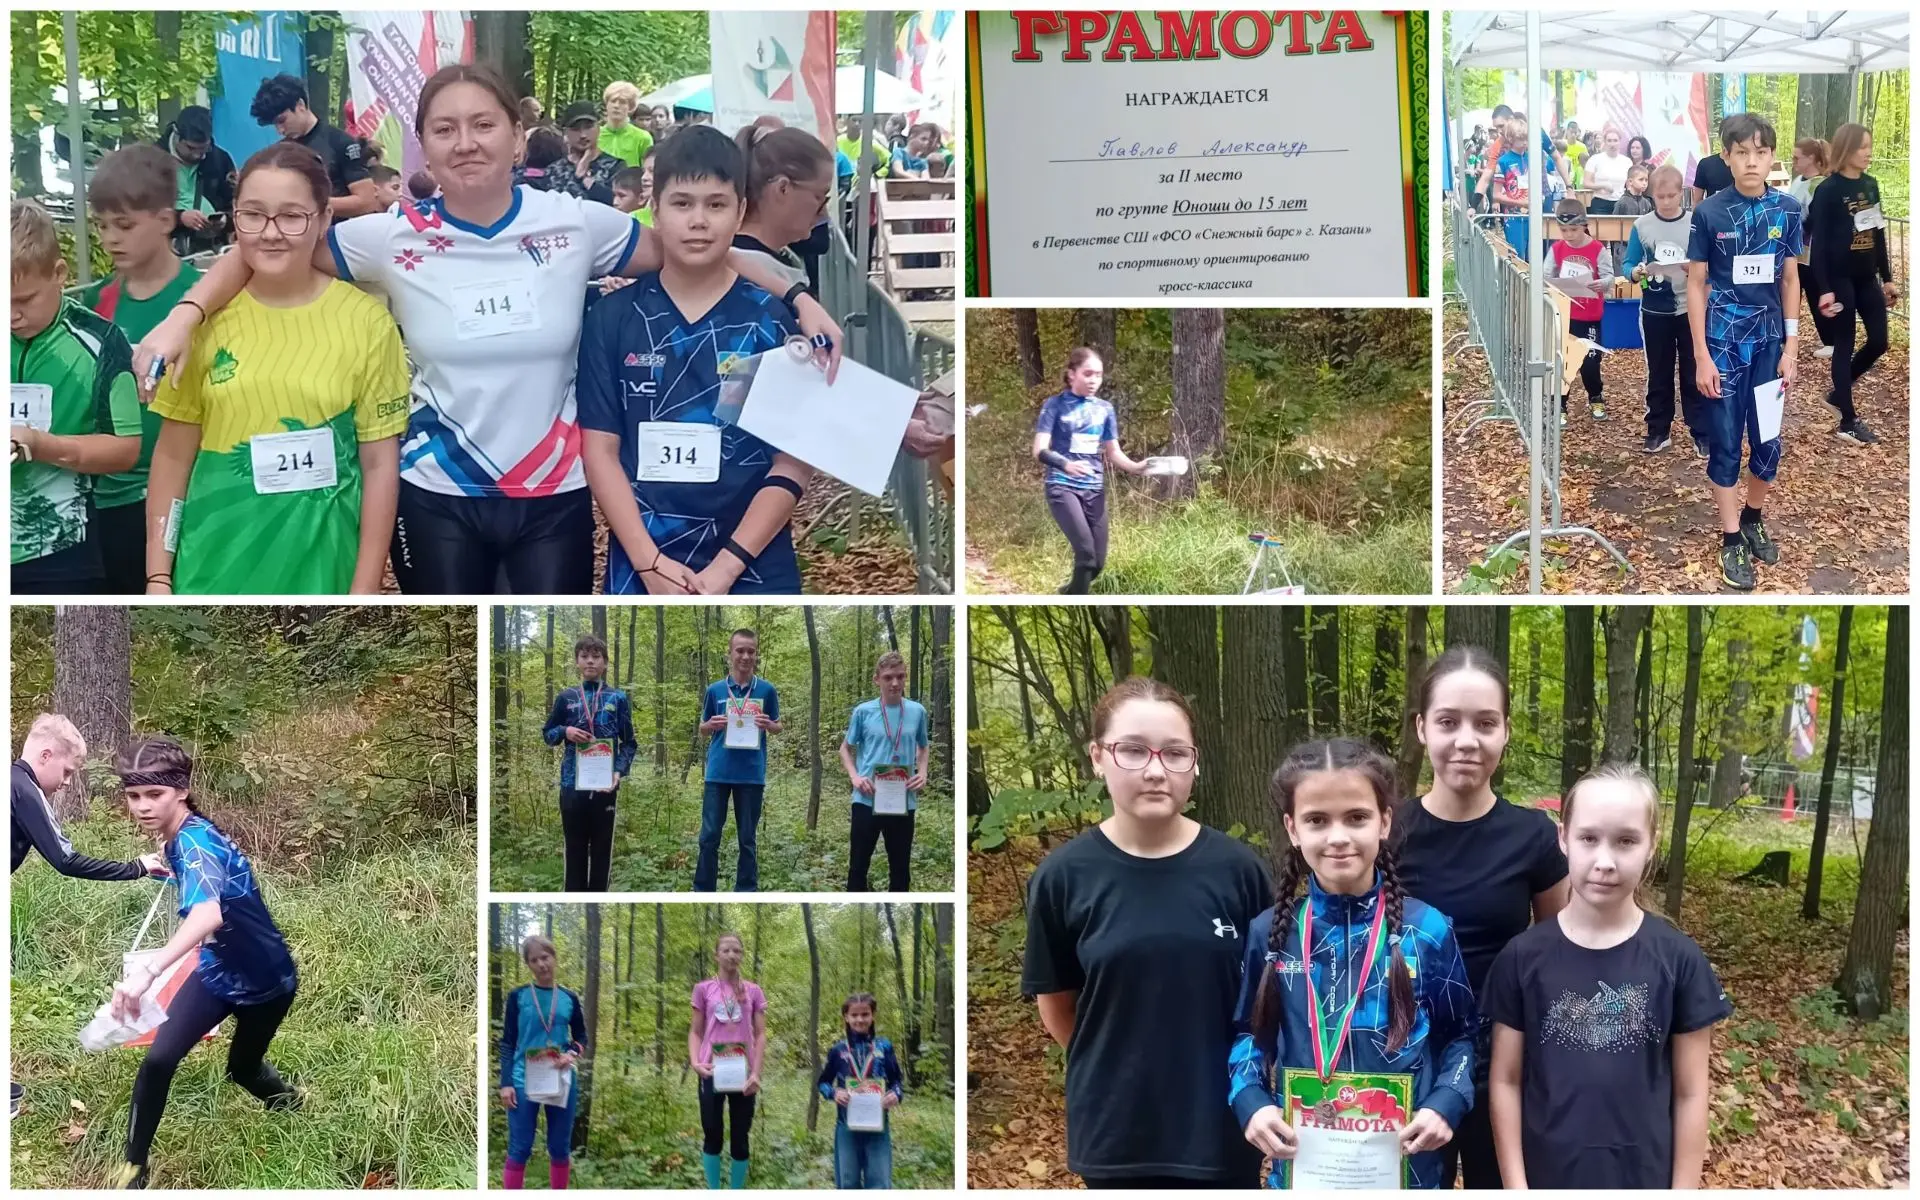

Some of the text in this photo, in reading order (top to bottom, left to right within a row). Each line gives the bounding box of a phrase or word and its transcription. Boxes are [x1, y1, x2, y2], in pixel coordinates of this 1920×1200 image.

[1012, 10, 1374, 62] ГРАМОТА
[1125, 89, 1269, 107] НАГРАЖДАЕТСЯ
[1098, 137, 1308, 157] Павлов Александр
[1158, 169, 1243, 183] за II место
[1095, 196, 1308, 219] по группе Юноши до 15 лет
[1032, 223, 1372, 250] в Первенстве СШ «ФСО «Снежный барс» г. Казани»
[1098, 252, 1311, 272] по спортивному ориентированию
[1742, 265, 1761, 276] 321
[1158, 279, 1254, 295] кросс-классика
[474, 295, 512, 316] 414
[277, 450, 314, 472] 214
[660, 446, 697, 465] 314
